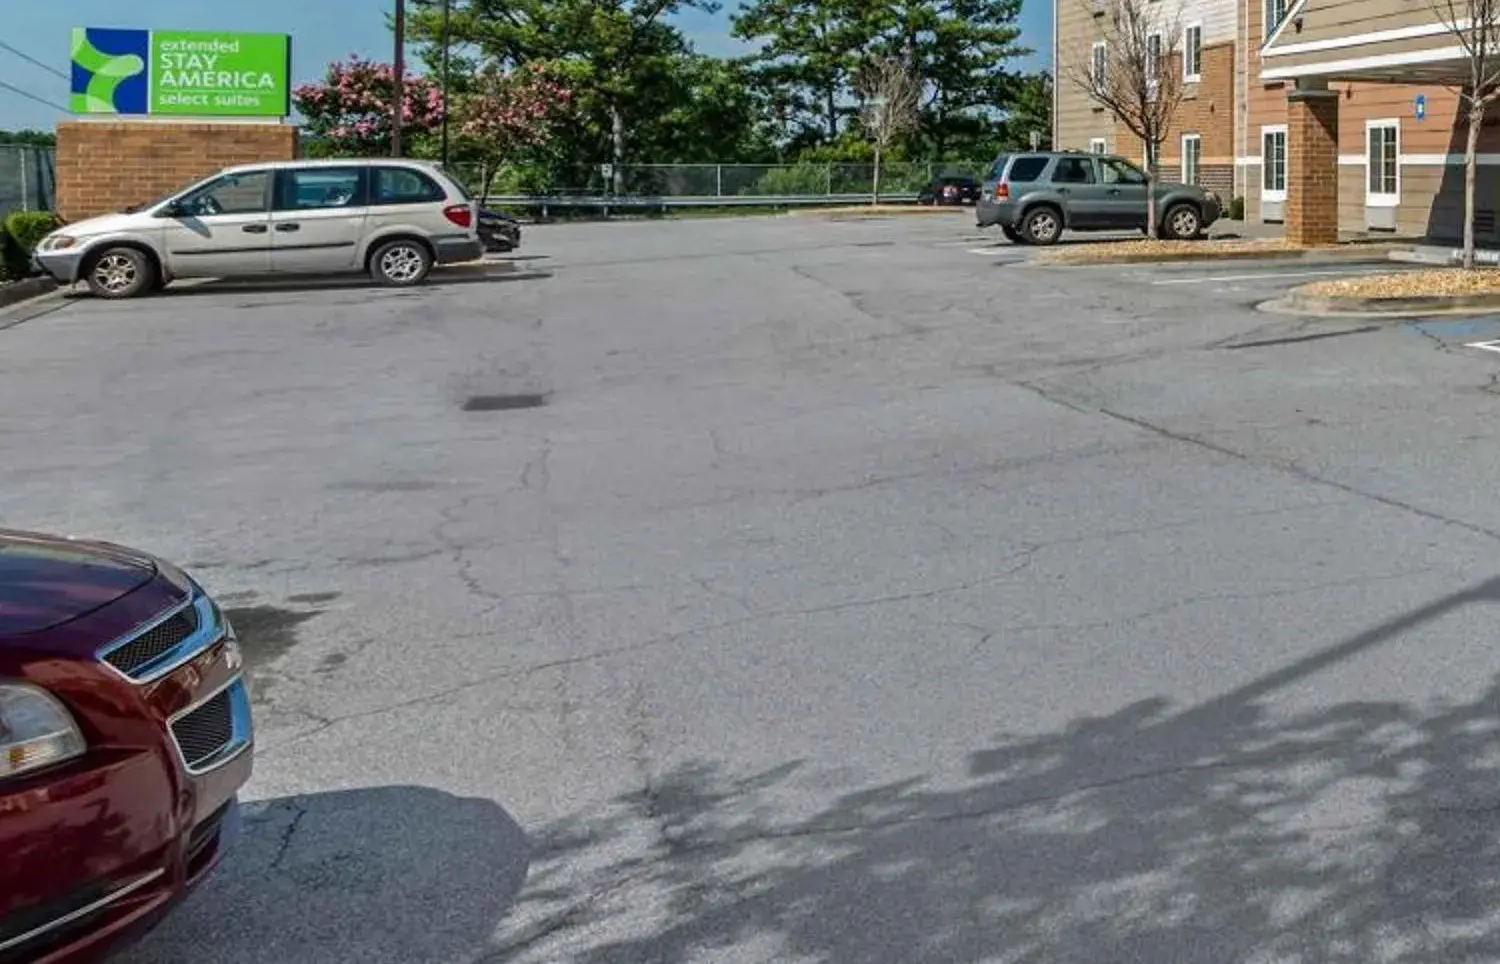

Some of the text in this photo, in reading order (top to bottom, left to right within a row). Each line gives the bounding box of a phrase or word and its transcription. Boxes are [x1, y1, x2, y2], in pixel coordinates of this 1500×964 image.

[159, 38, 240, 53] extended
[159, 53, 218, 70] STAY
[159, 70, 275, 89] AMERICA
[159, 91, 261, 107] select suites
